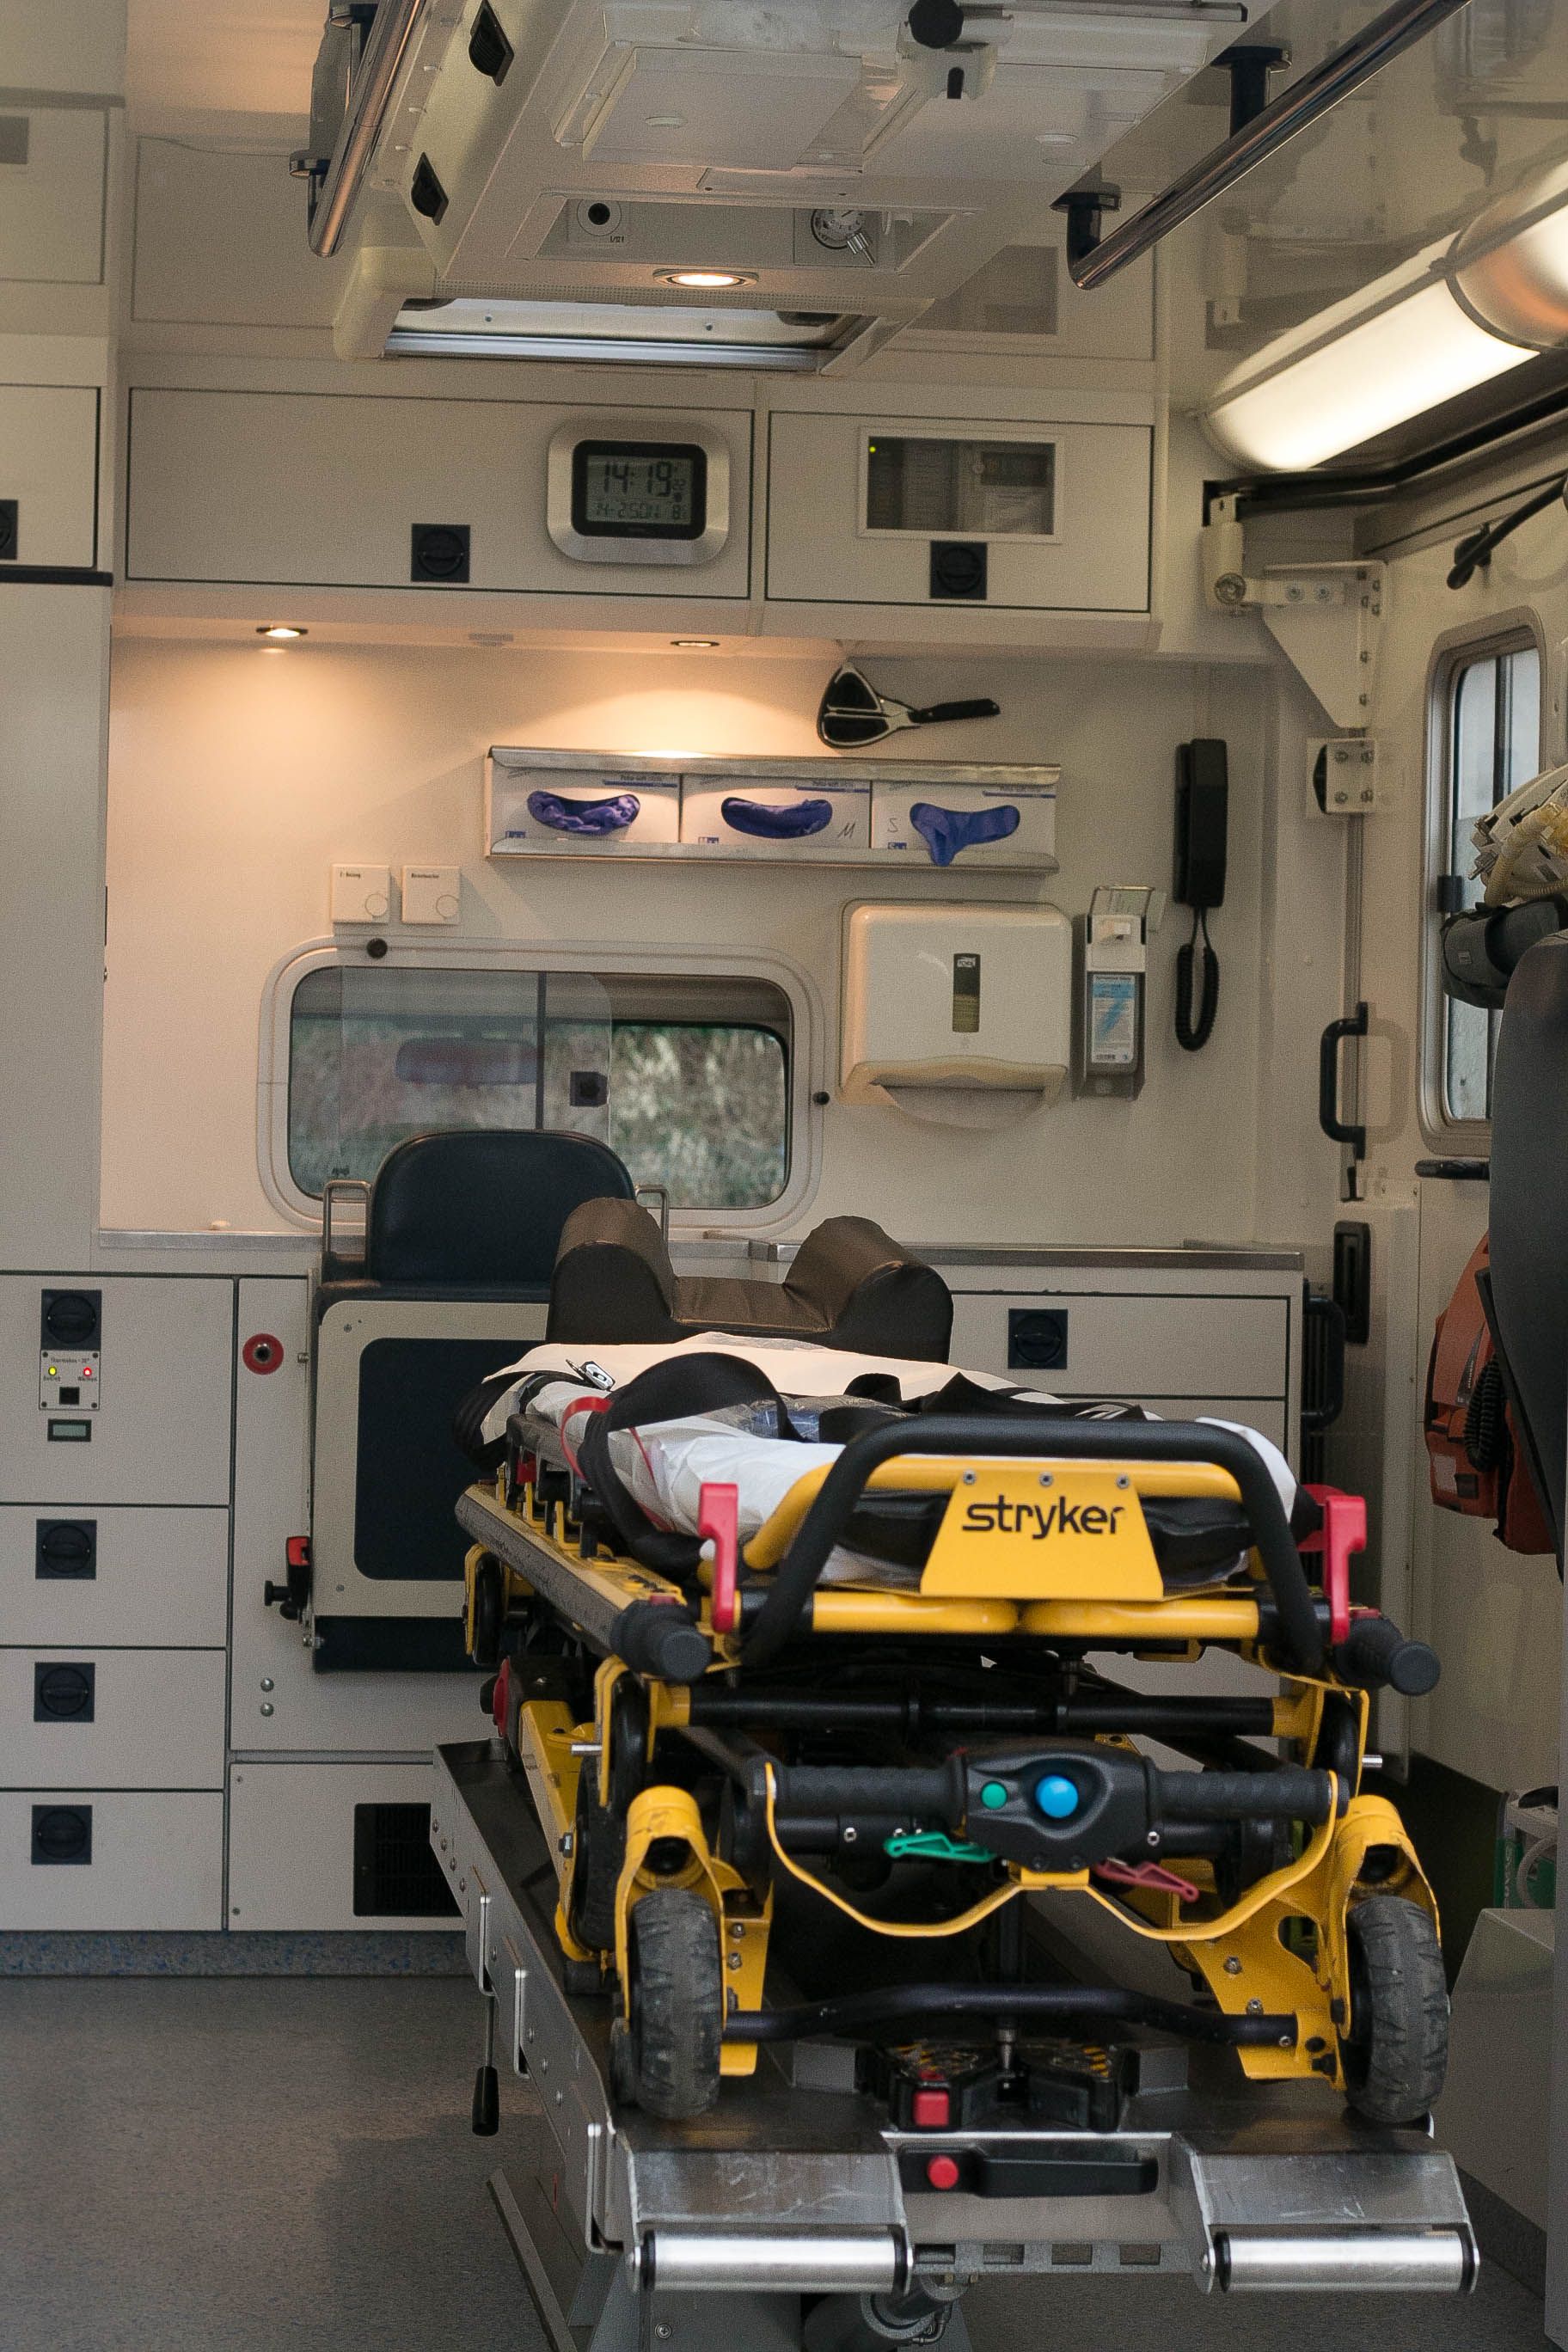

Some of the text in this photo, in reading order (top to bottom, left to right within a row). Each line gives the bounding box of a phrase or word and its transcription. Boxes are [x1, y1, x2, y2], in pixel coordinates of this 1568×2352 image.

[603, 461, 672, 497] 14:19
[837, 822, 856, 838] M
[887, 818, 898, 833] S
[962, 1494, 1125, 1540] stryker
